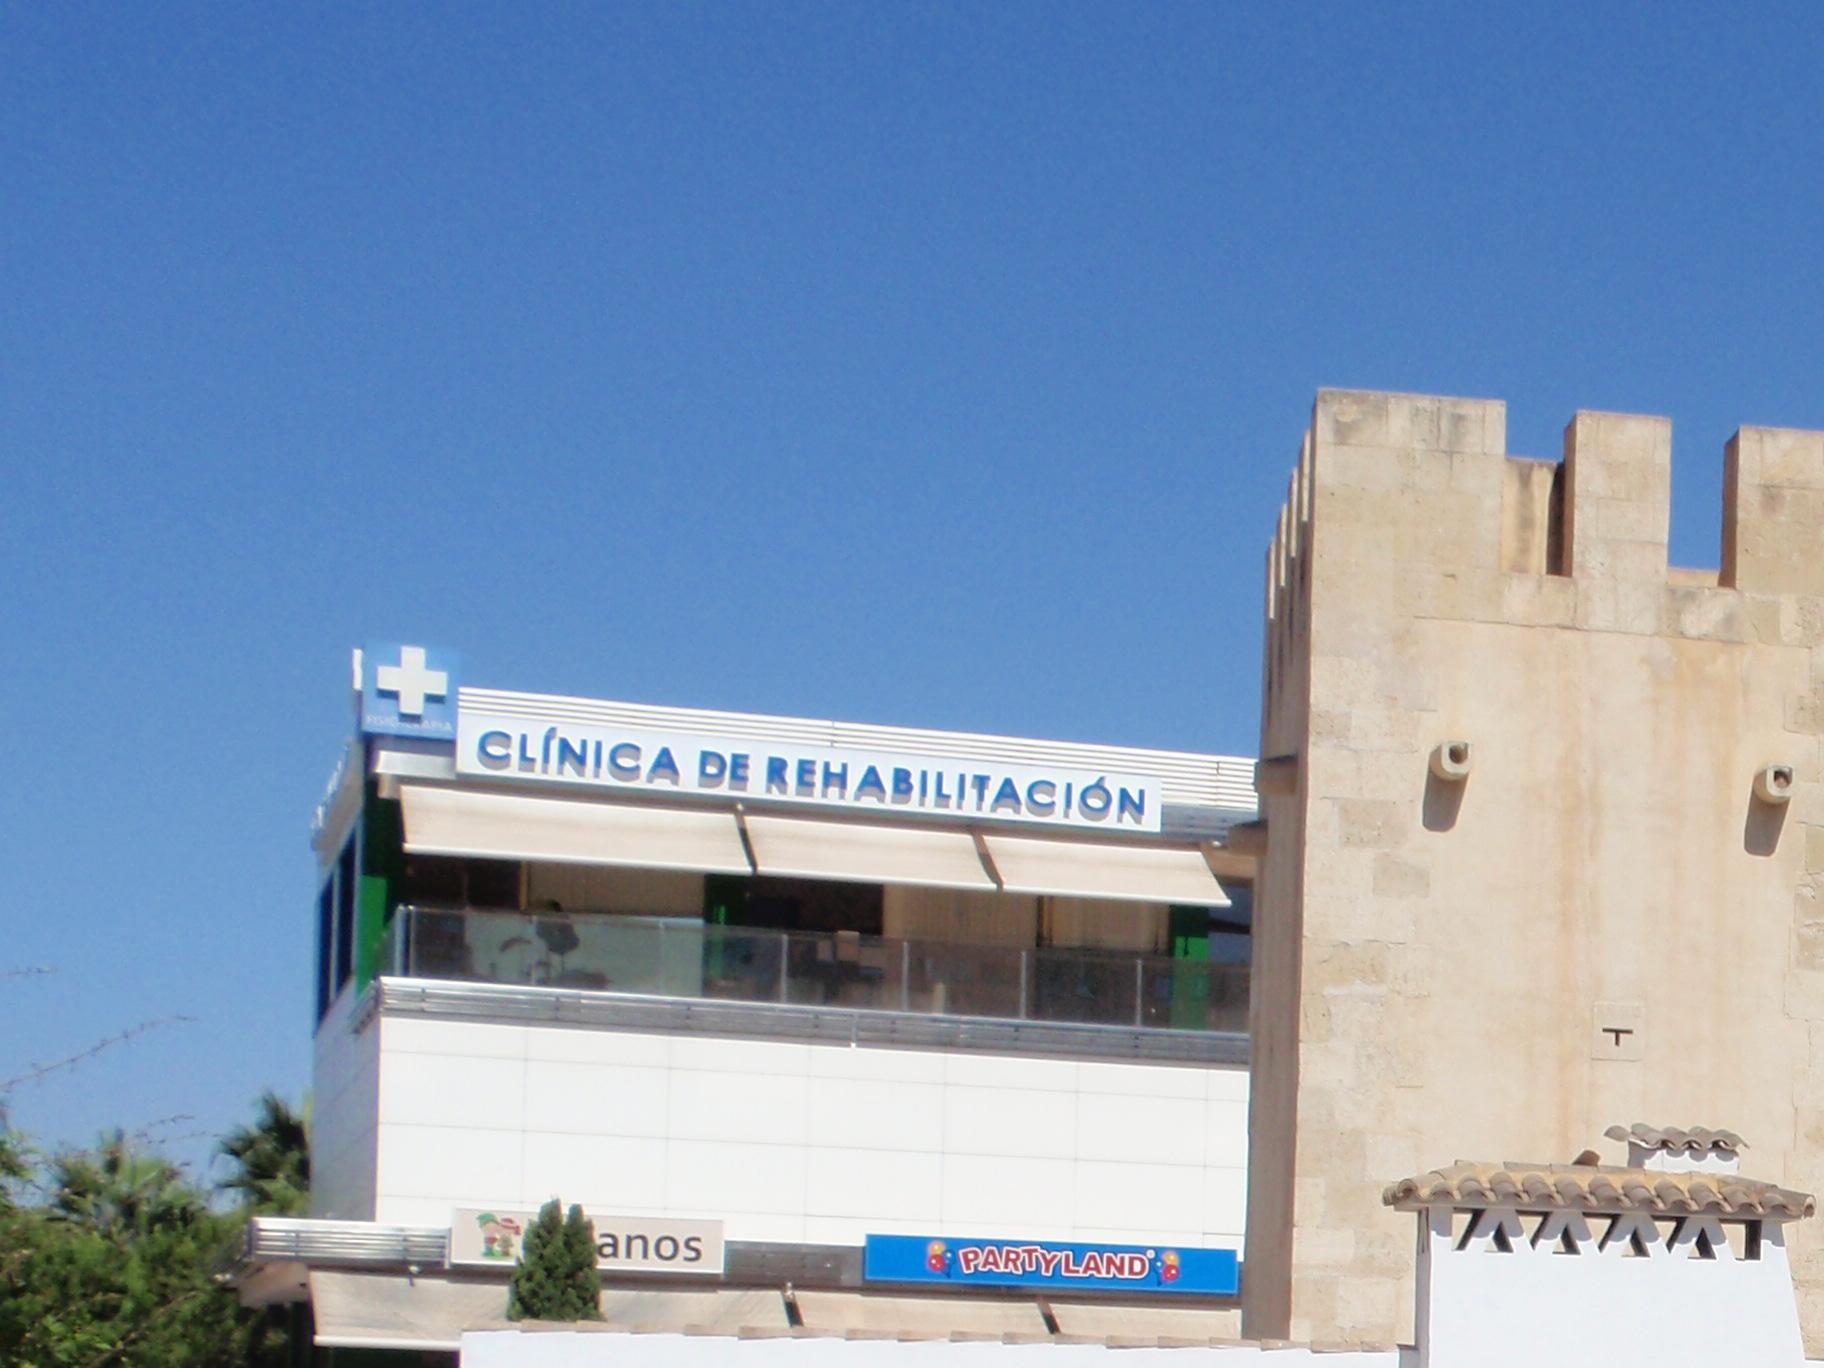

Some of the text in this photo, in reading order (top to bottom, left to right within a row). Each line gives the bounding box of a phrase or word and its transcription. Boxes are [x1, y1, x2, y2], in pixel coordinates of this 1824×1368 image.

[477, 727, 1147, 820] CLÍNICA DE REHABILITACIÓN
[958, 1245, 1149, 1280] PARTYLAND
